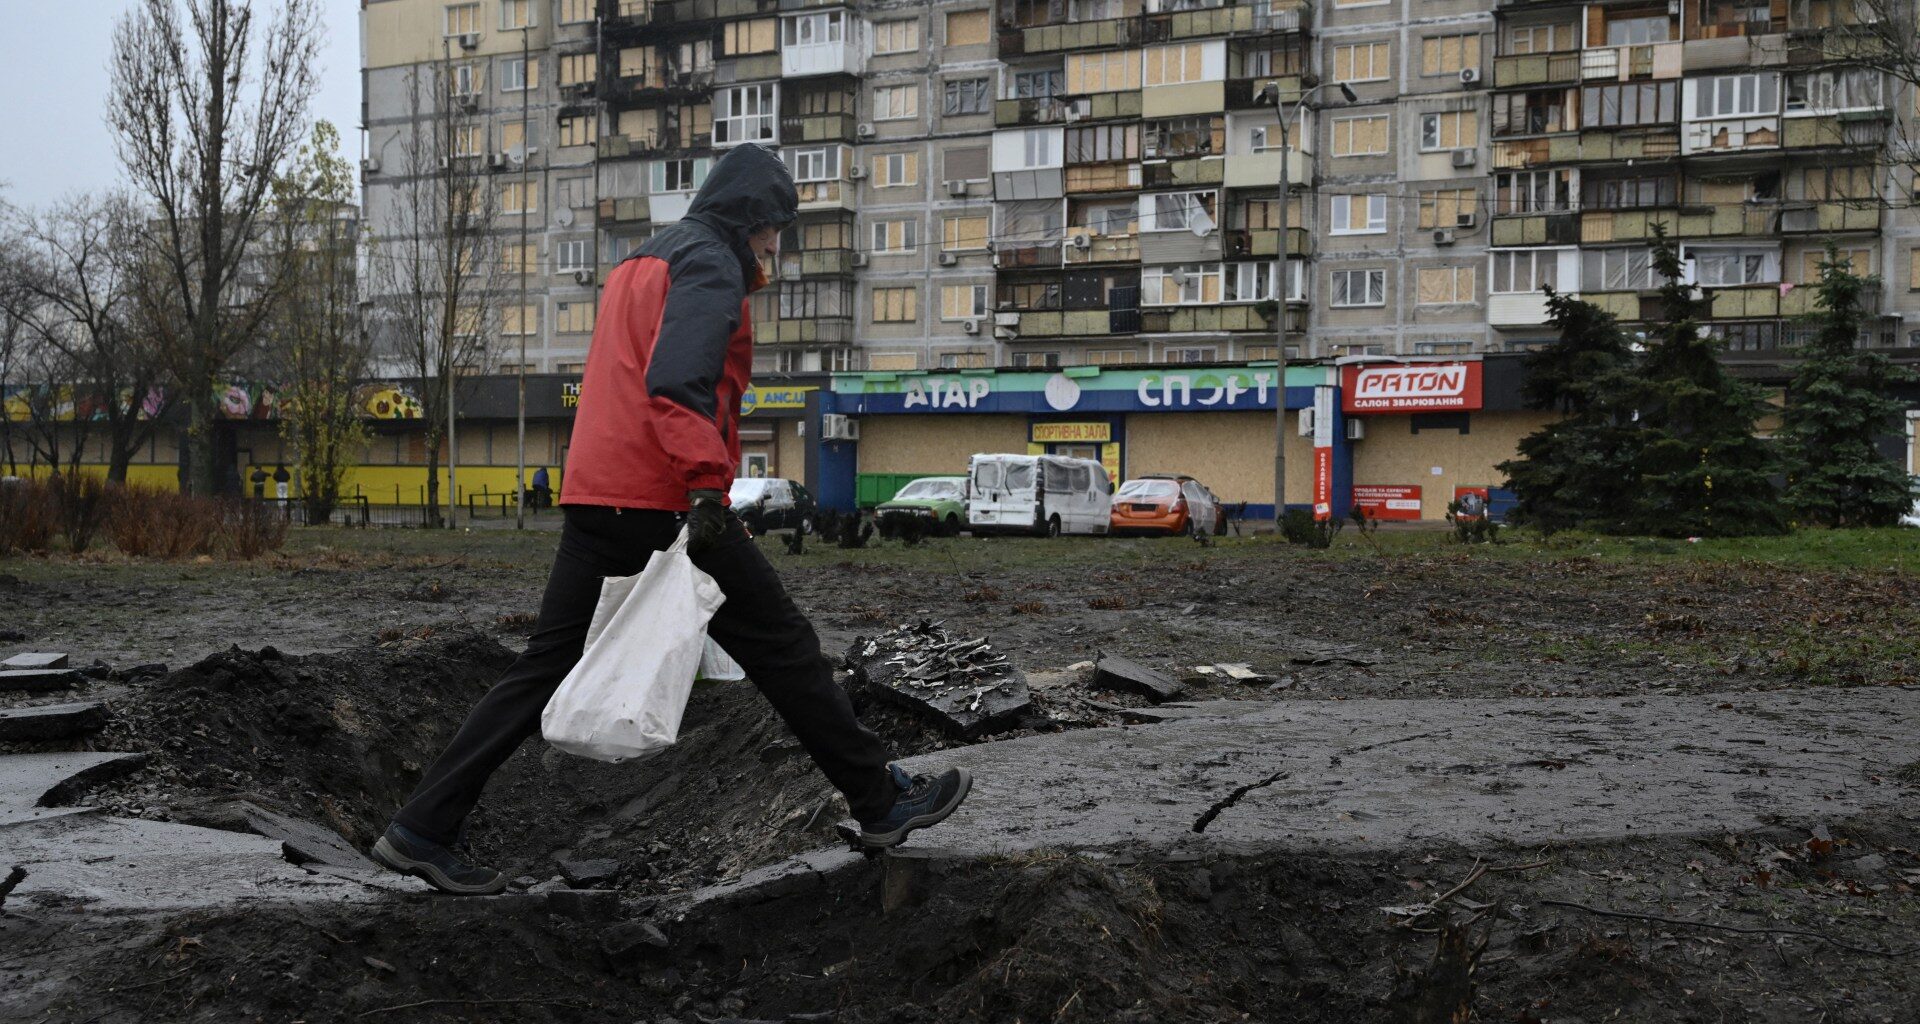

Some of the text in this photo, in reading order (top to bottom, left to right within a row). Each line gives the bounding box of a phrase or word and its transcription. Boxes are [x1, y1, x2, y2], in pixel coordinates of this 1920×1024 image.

[1137, 372, 1271, 406] СПОРТ
[1361, 371, 1460, 393] PATON
[1354, 397, 1464, 408] САЛОН ЗВАРЮВАННЯ
[1034, 424, 1107, 439] СПОРТИВНА ЗАЛА
